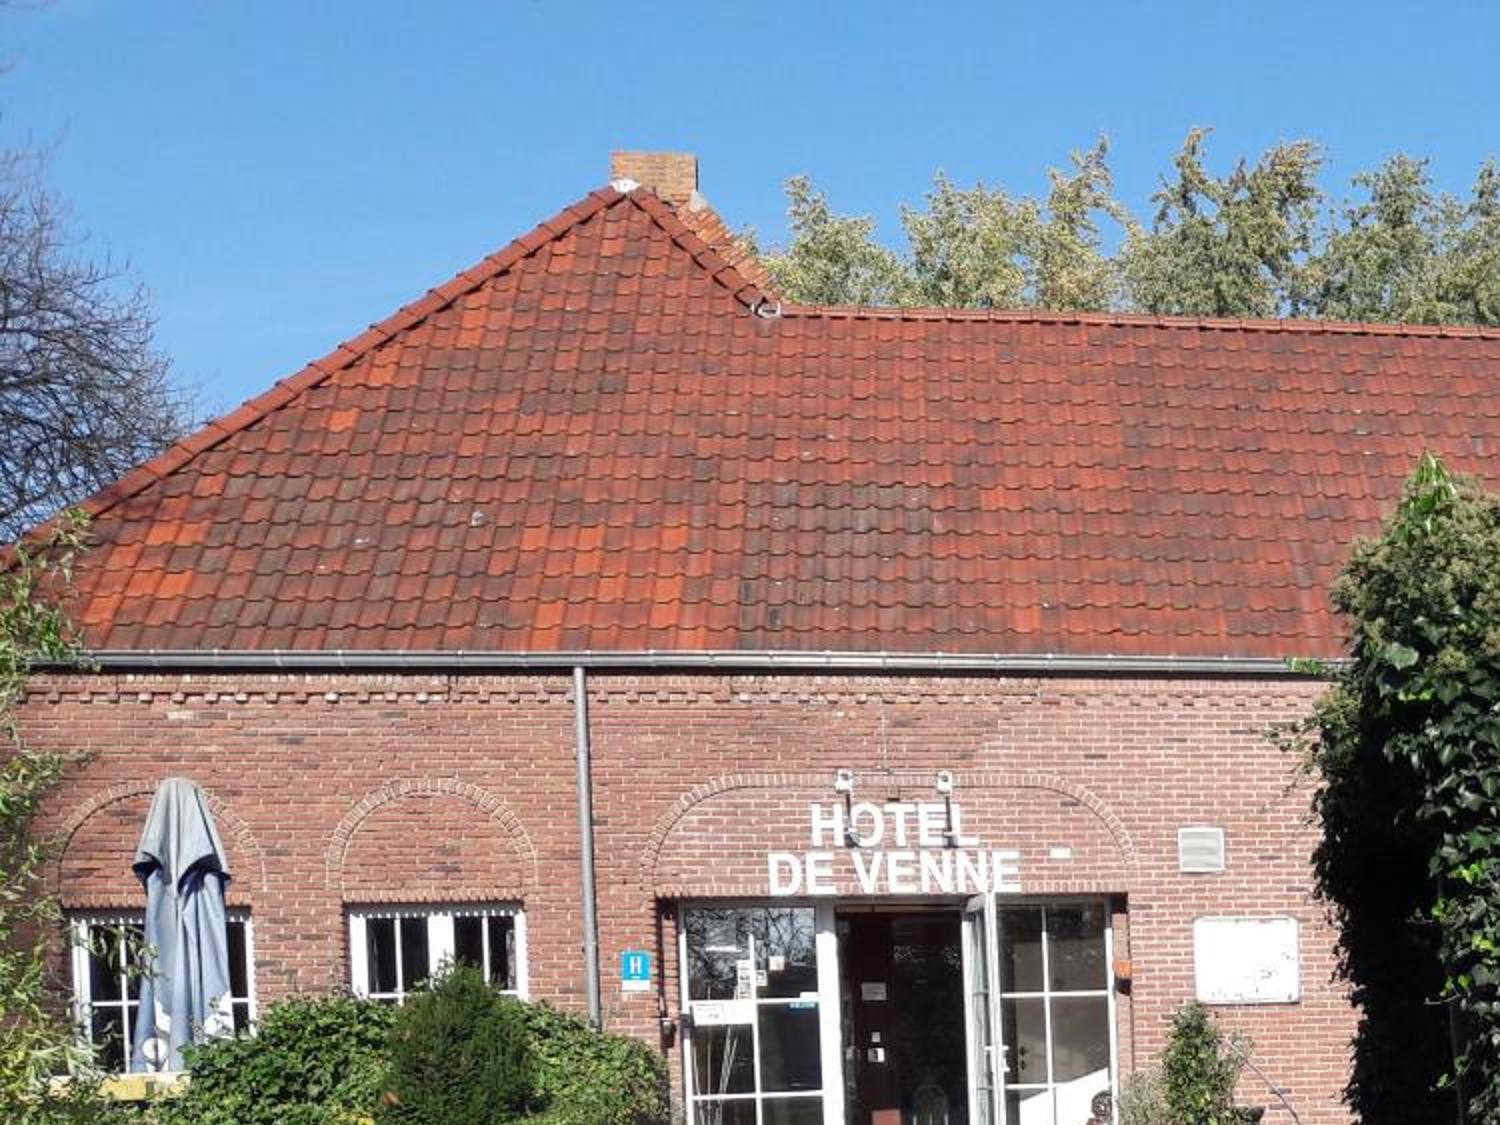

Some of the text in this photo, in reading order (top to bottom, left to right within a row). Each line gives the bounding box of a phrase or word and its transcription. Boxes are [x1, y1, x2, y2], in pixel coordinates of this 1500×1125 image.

[811, 801, 979, 848] HOTEL
[768, 851, 1022, 896] DE VENNE
[630, 955, 642, 974] H
